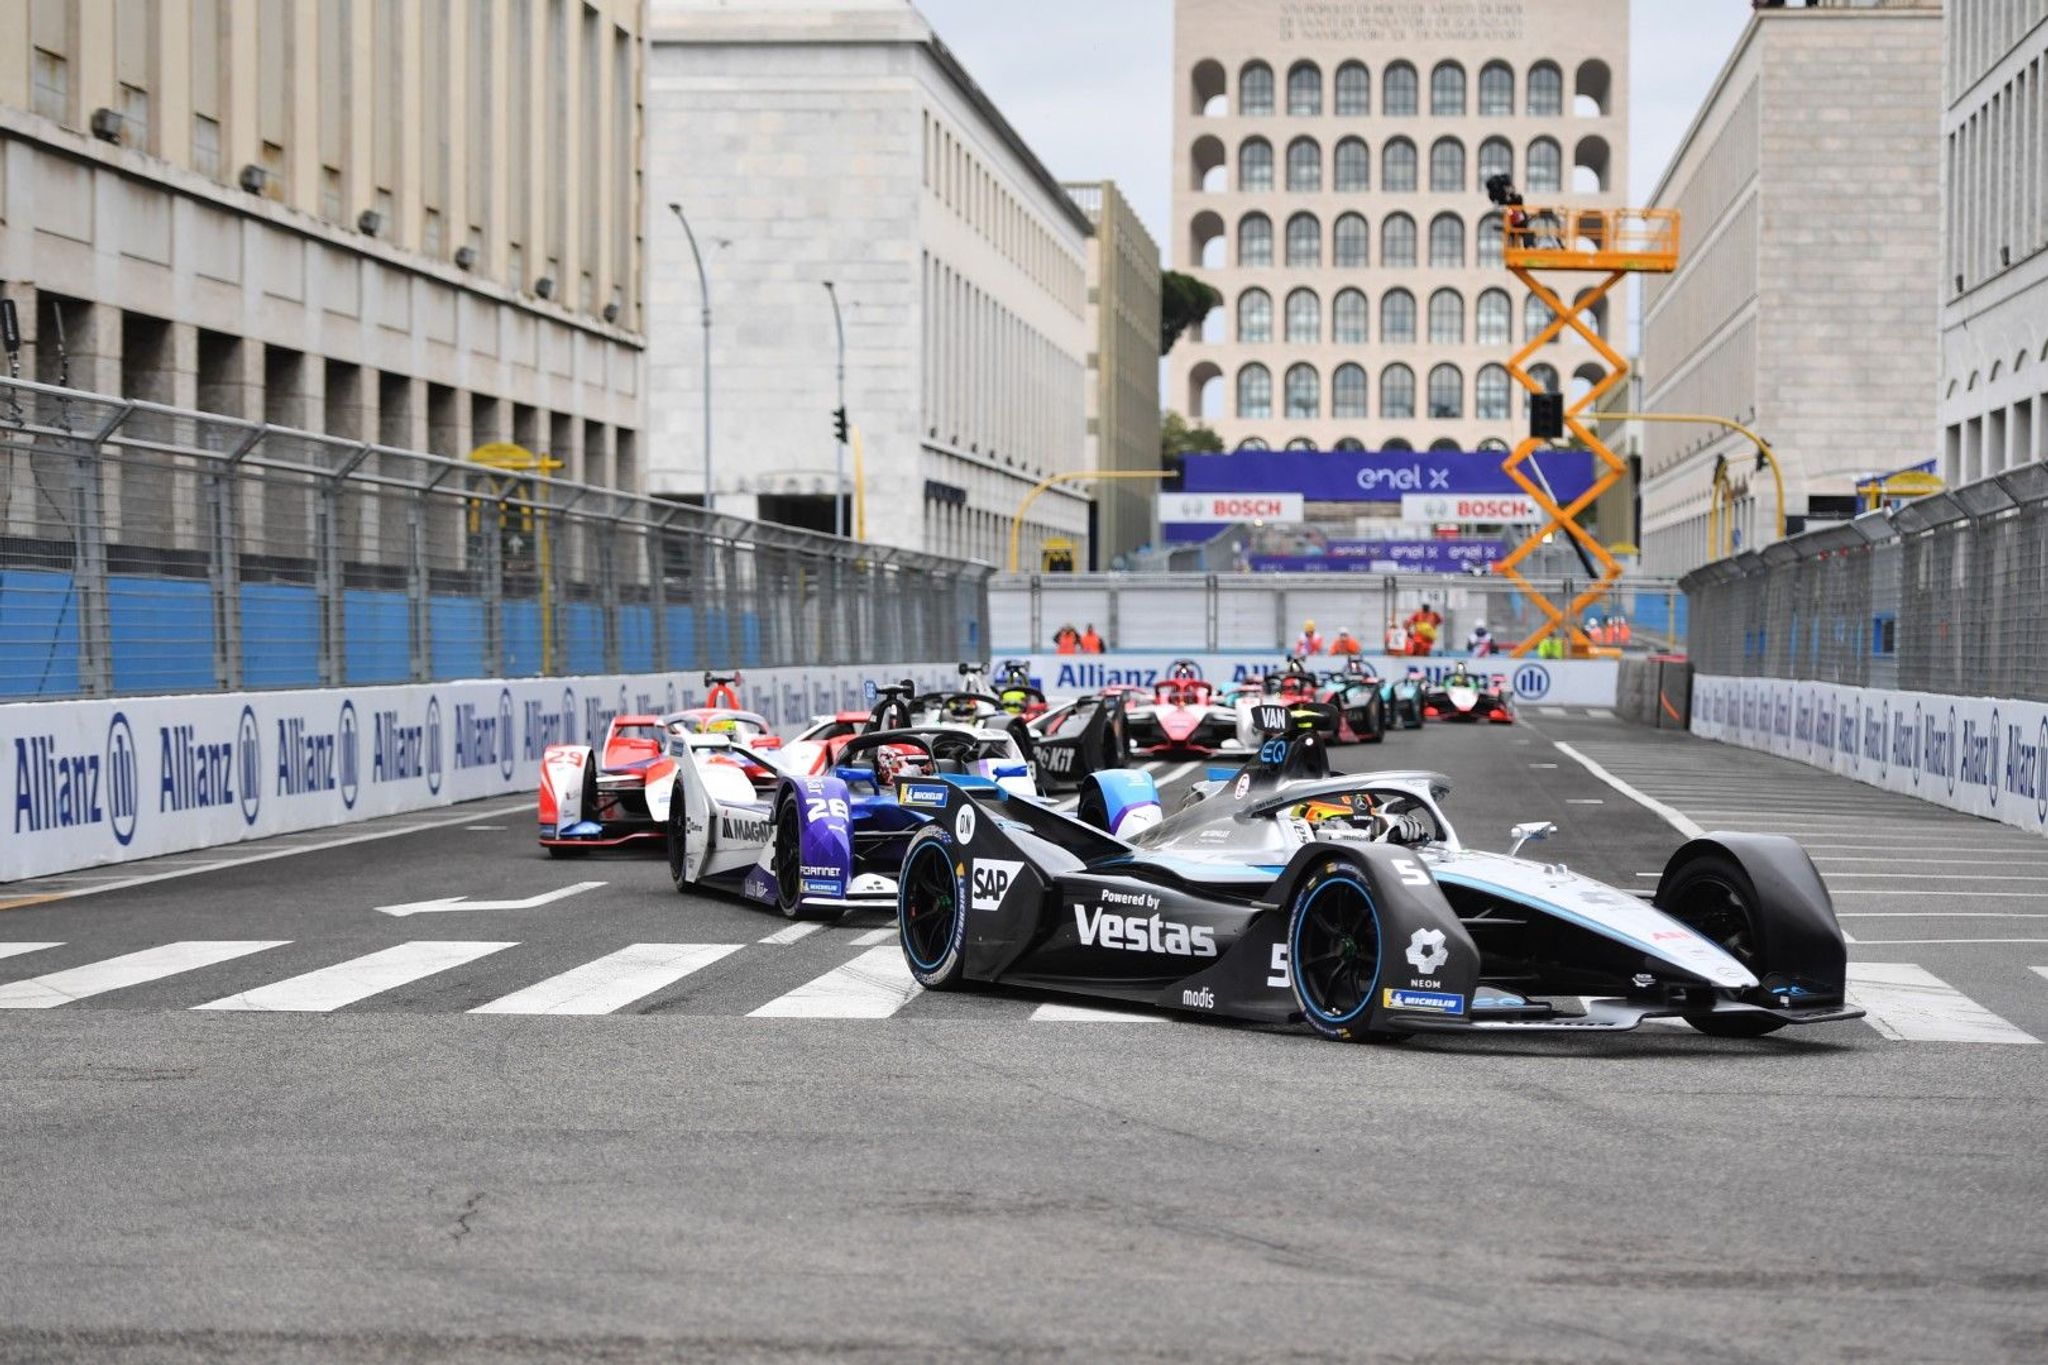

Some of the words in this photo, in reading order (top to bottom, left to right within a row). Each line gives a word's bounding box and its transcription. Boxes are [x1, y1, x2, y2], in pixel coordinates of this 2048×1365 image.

[1356, 464, 1421, 491] enel
[1213, 500, 1282, 517] BOSCH
[1457, 501, 1526, 517] BOSCH
[1057, 664, 1157, 689] Allianz
[1261, 707, 1286, 730] VAN
[372, 711, 423, 784] Allianz
[455, 704, 497, 769] Allianz
[277, 718, 335, 798] Allianz
[548, 751, 583, 768] 29
[1260, 740, 1288, 763] EQ
[2005, 724, 2036, 799] Allianz
[160, 726, 233, 813] Allianz
[14, 735, 102, 834] Allianz
[913, 789, 945, 801] MICHELIN
[959, 814, 971, 835] ON
[973, 867, 1008, 901] SAP
[1391, 859, 1432, 886] 5
[1101, 889, 1145, 907] Powered
[1147, 894, 1161, 910] by
[1073, 903, 1218, 957] Vestas
[1266, 943, 1292, 988] 5
[1410, 978, 1441, 989] NEOM
[1182, 987, 1215, 1009] modis
[1404, 997, 1457, 1008] MICHELIN
